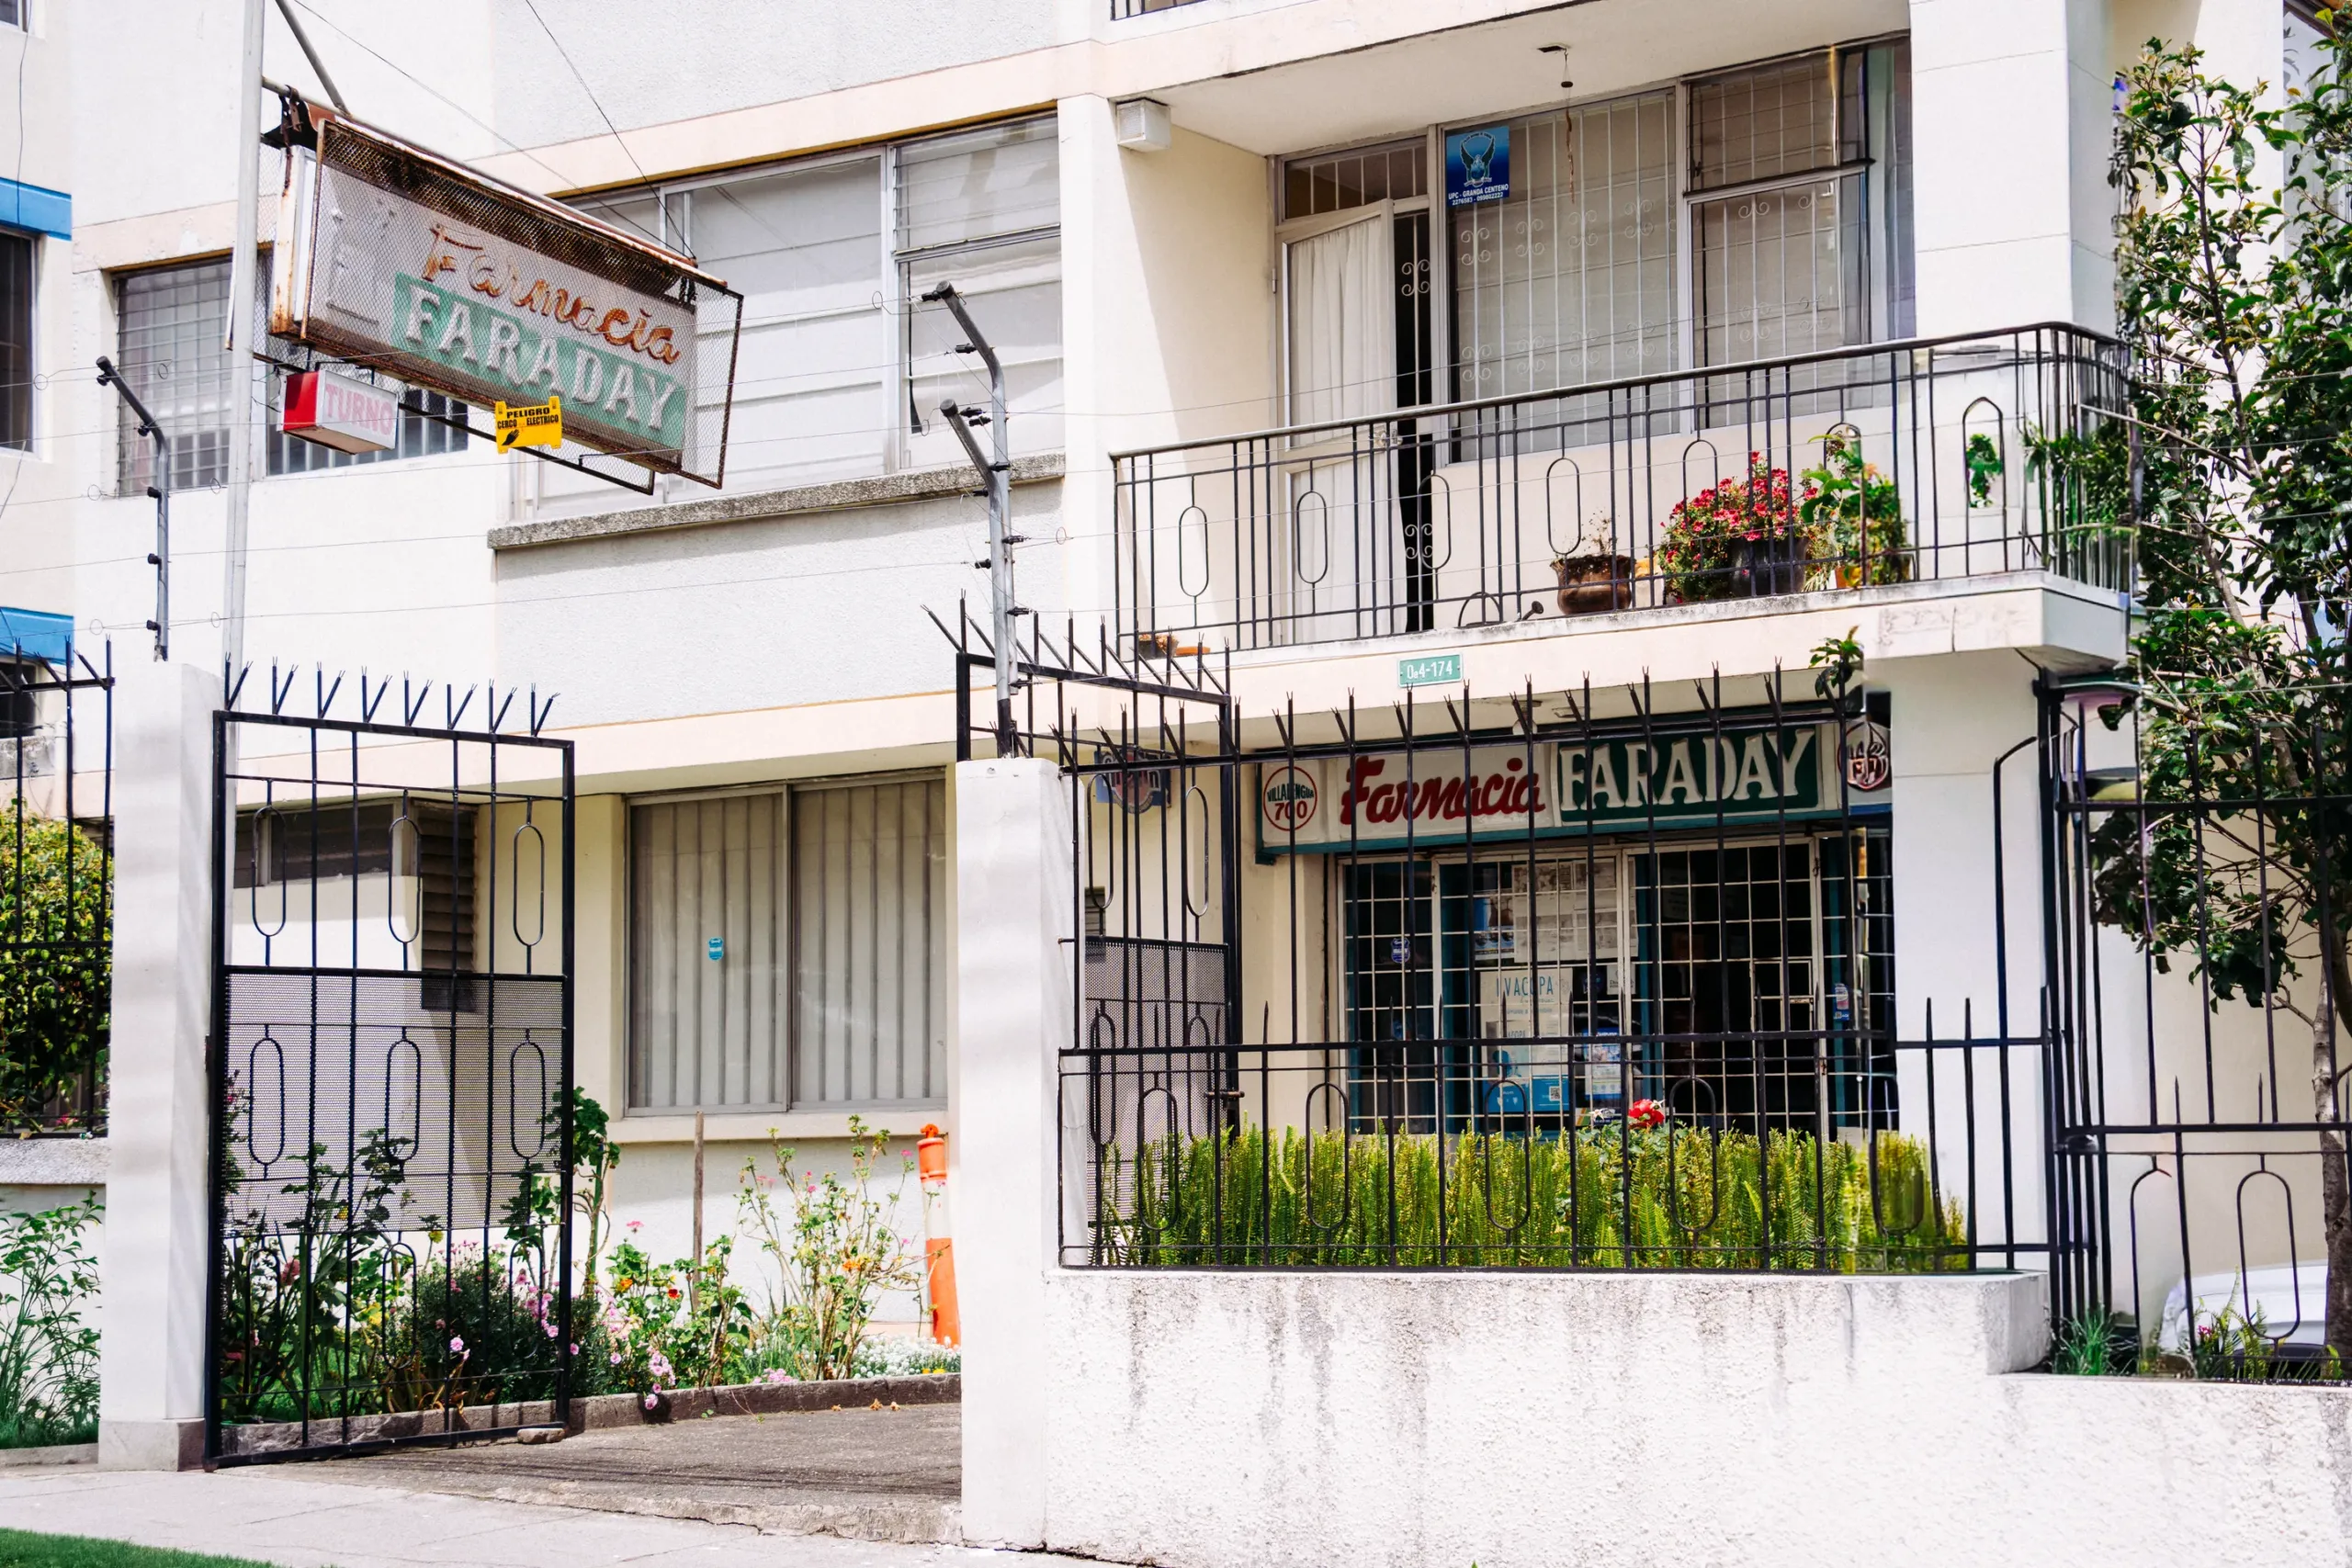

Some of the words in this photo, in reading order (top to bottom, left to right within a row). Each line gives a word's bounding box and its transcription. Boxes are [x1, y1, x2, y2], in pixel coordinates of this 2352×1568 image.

[1463, 188, 1484, 197] GRANDA
[1485, 184, 1509, 194] CENTENO
[422, 223, 682, 365] Farmacia
[404, 278, 675, 433] FARADAY
[325, 383, 394, 436] TURNO
[497, 419, 518, 430] CERCO
[526, 414, 560, 426] ELECTRICO
[506, 407, 550, 419] PELIGRO
[1266, 783, 1315, 802] VILLALNGUA
[1340, 755, 1546, 826] Farmacia
[1559, 728, 1815, 811] FARADAY
